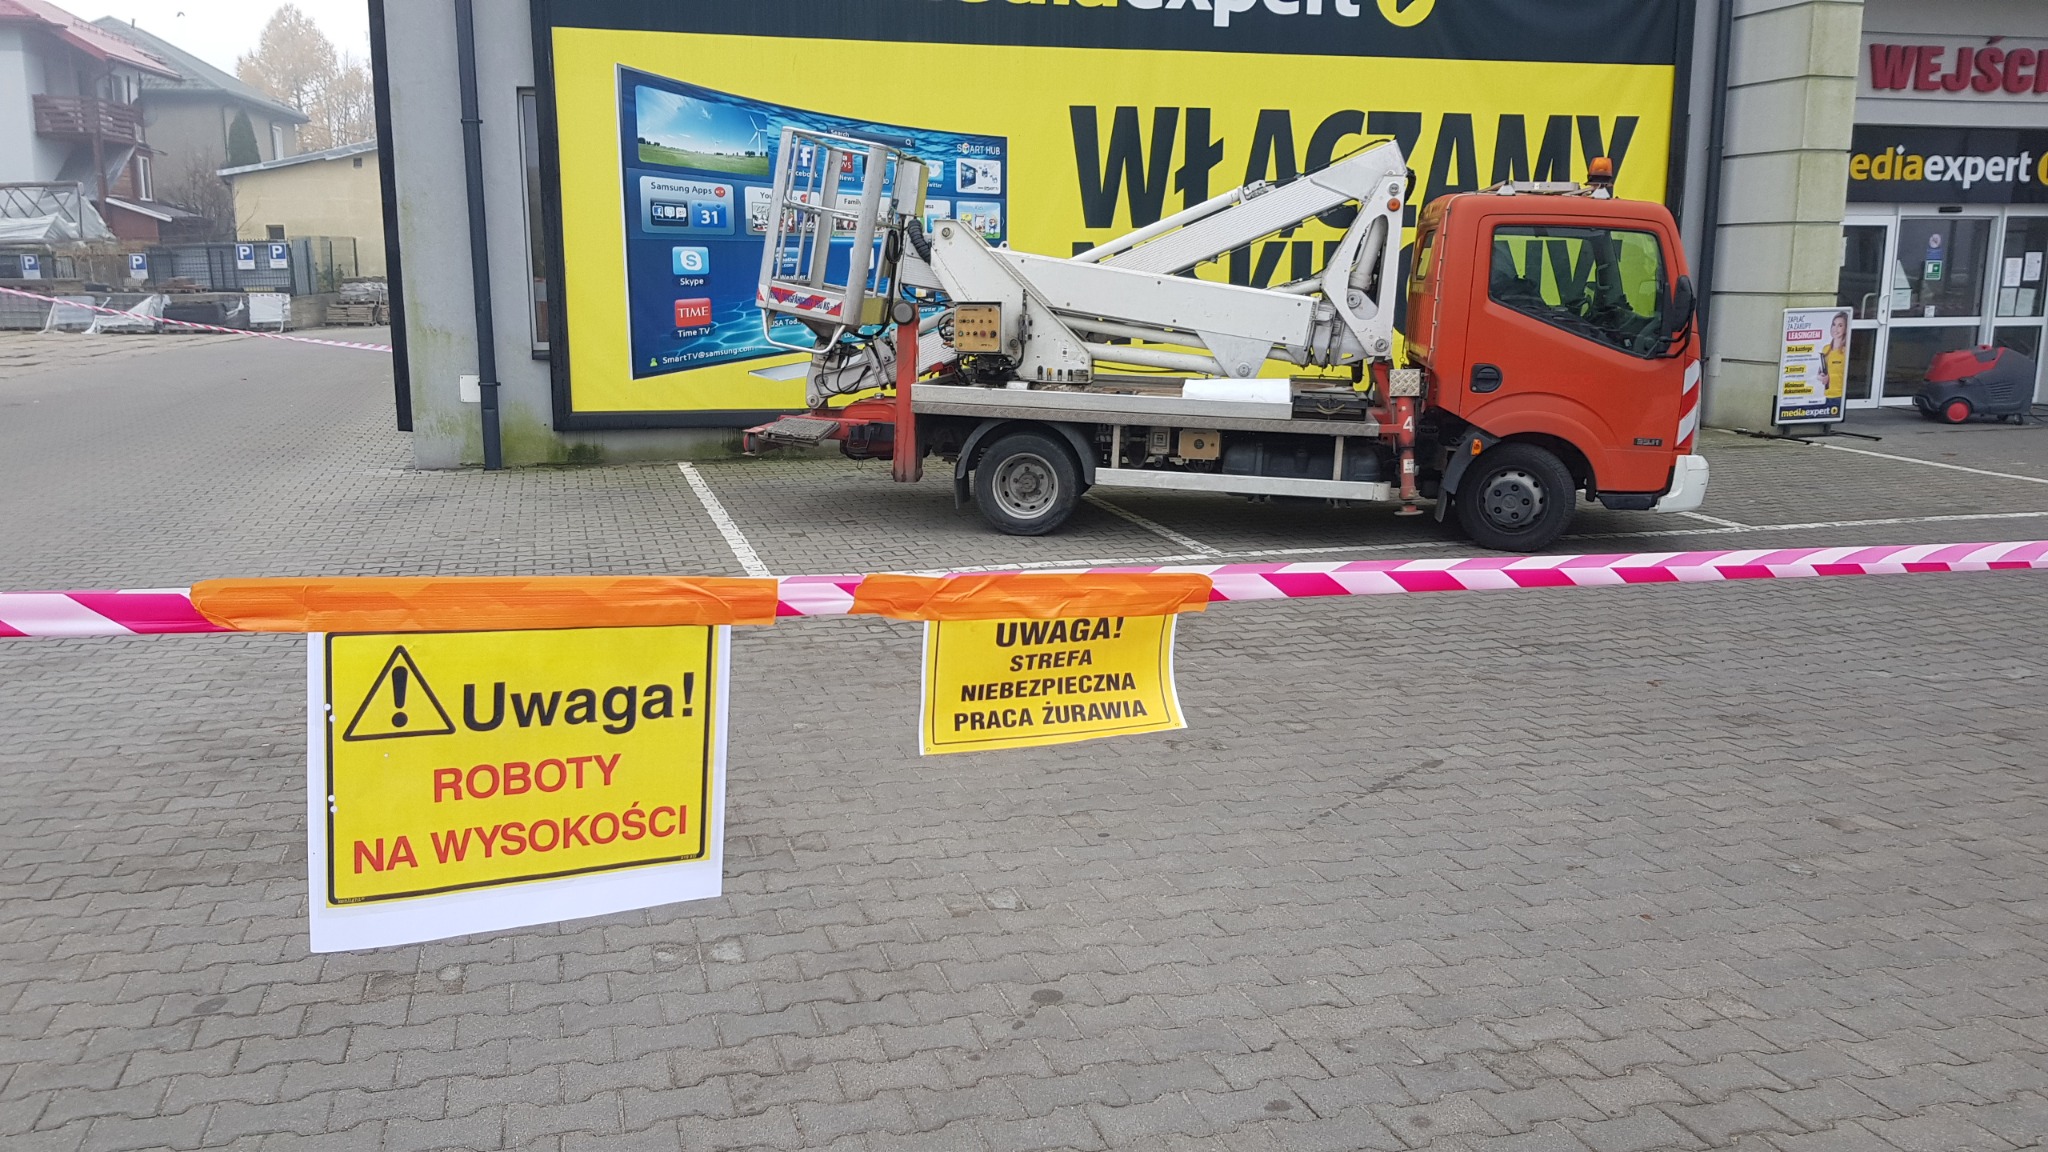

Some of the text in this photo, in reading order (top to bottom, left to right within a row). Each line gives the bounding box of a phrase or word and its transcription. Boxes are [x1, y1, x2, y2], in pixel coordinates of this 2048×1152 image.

[985, 146, 1001, 156] HUB
[1849, 144, 2032, 189] ediaexpert
[650, 181, 690, 194] Samsung
[691, 185, 713, 195] Apps
[700, 209, 719, 225] 31
[238, 246, 251, 260] P
[271, 245, 283, 259] P
[23, 255, 35, 269] P
[132, 255, 143, 269] P
[680, 277, 704, 286] Skype
[677, 306, 709, 319] TIME
[677, 327, 711, 338] Time TV
[662, 346, 755, 364] SmartTV@samsung.com
[1781, 406, 1830, 418] mediaexpert
[1402, 415, 1413, 433] 4
[996, 616, 1124, 648] UWAGA!
[1009, 648, 1093, 673] STREFA
[960, 671, 1137, 702] NIEBEZPIECZNA
[462, 672, 695, 735] Uwaga!
[954, 699, 1148, 732] PRACA ŻURAWIA
[433, 753, 622, 803] ROBOTY
[353, 801, 688, 875] NA WYSOKOŚCI
